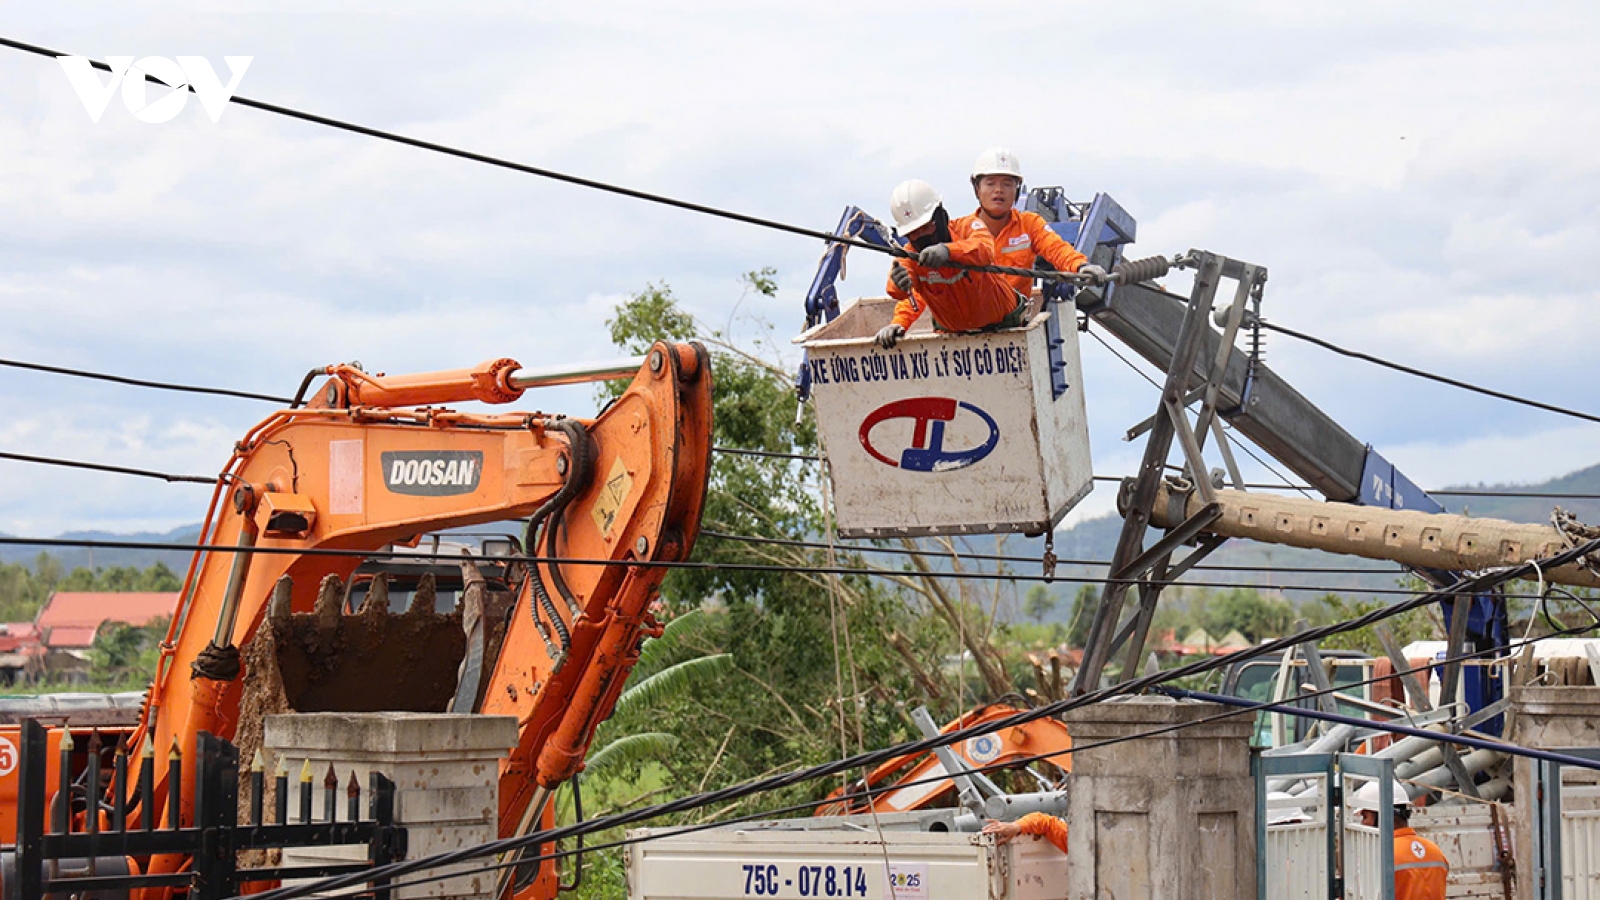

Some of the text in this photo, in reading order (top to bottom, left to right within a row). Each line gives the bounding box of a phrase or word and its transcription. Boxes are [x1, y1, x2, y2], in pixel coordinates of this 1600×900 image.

[810, 359, 829, 384] XE
[830, 352, 860, 383] ỨNG
[889, 348, 909, 379] VÀ
[953, 347, 972, 380] SỰ
[390, 459, 474, 485] DOOSAN
[742, 864, 779, 895] 75C
[798, 865, 867, 897] 078.14
